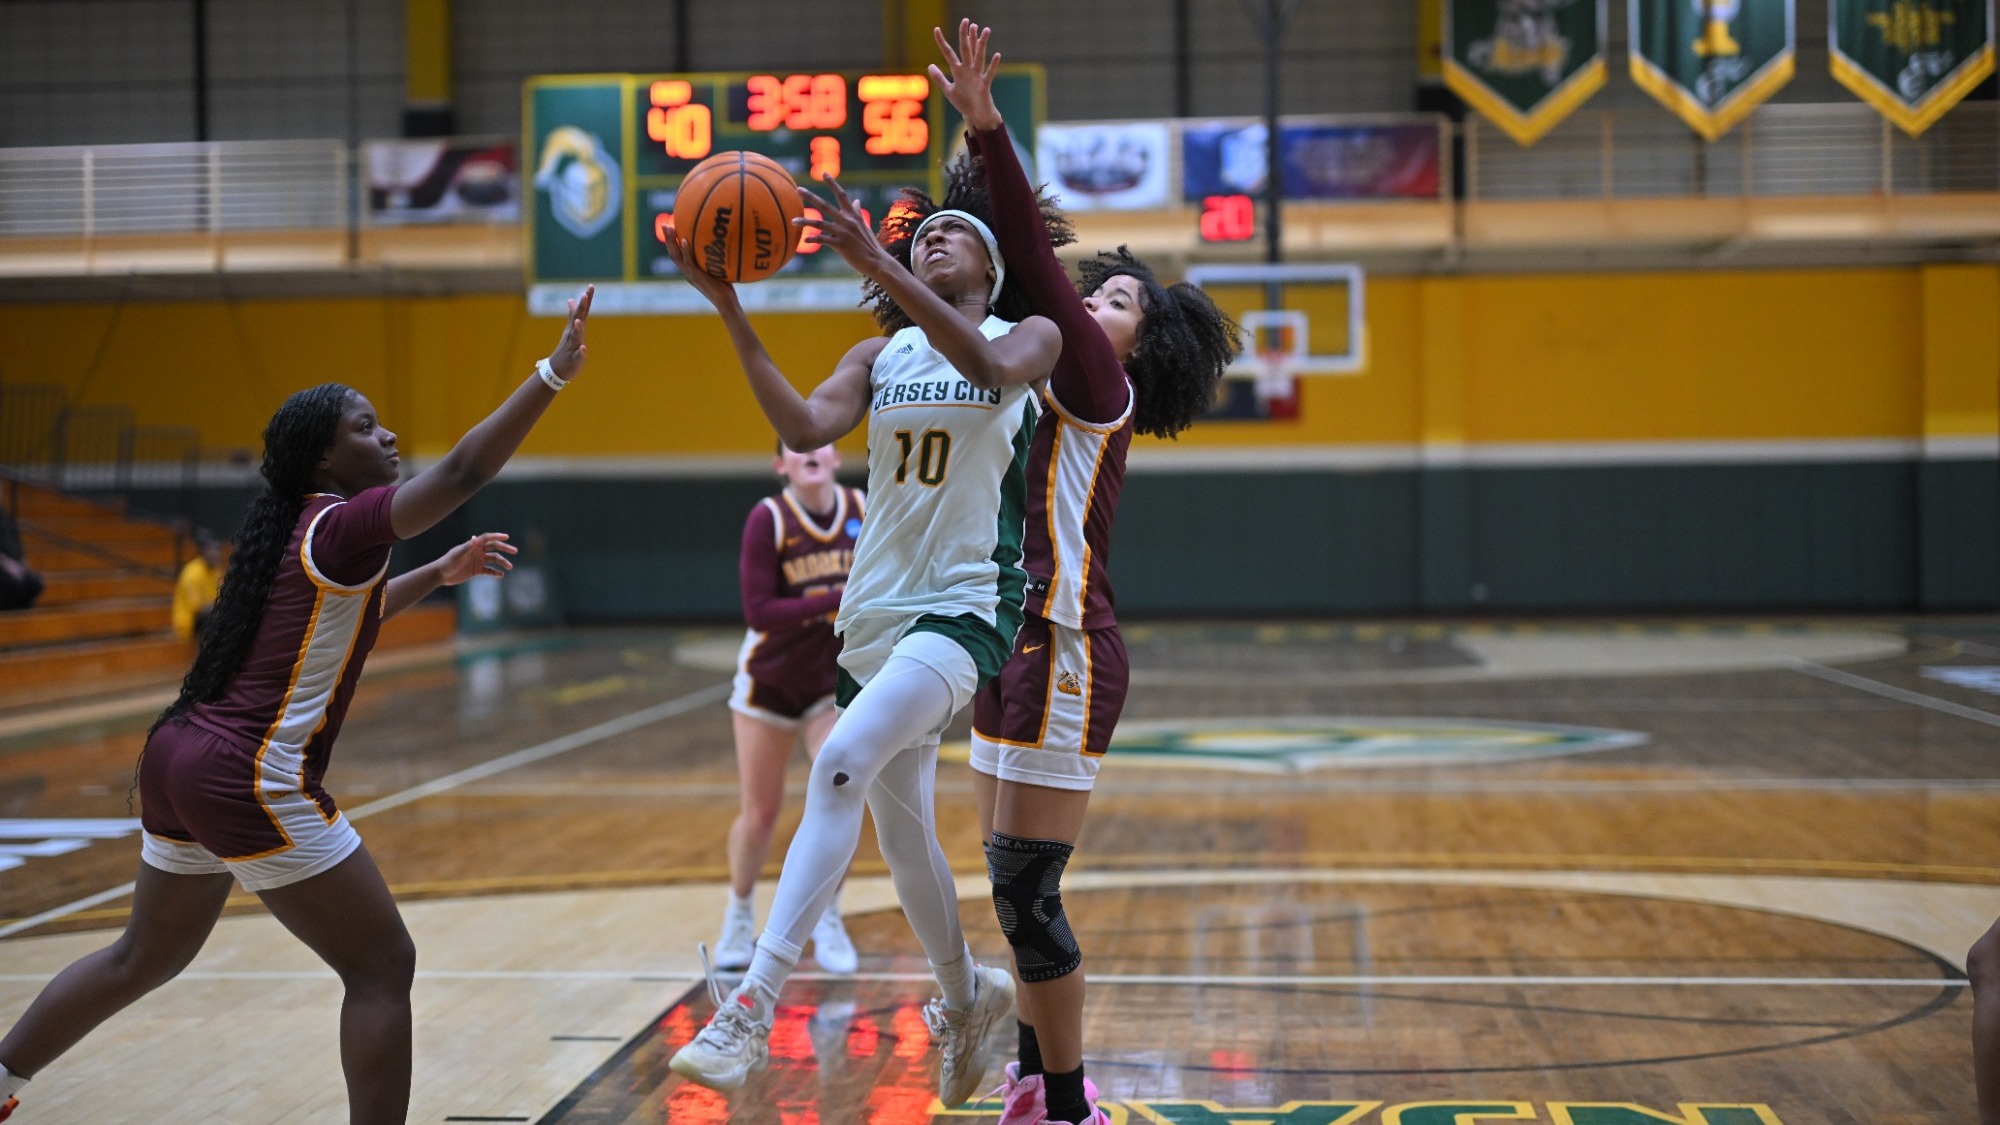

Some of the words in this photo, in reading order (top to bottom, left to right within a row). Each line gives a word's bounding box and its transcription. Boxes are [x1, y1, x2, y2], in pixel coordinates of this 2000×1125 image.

[647, 103, 711, 159] 40
[863, 99, 929, 155] 56
[875, 381, 949, 411] JERSEY
[894, 428, 952, 488] 10
